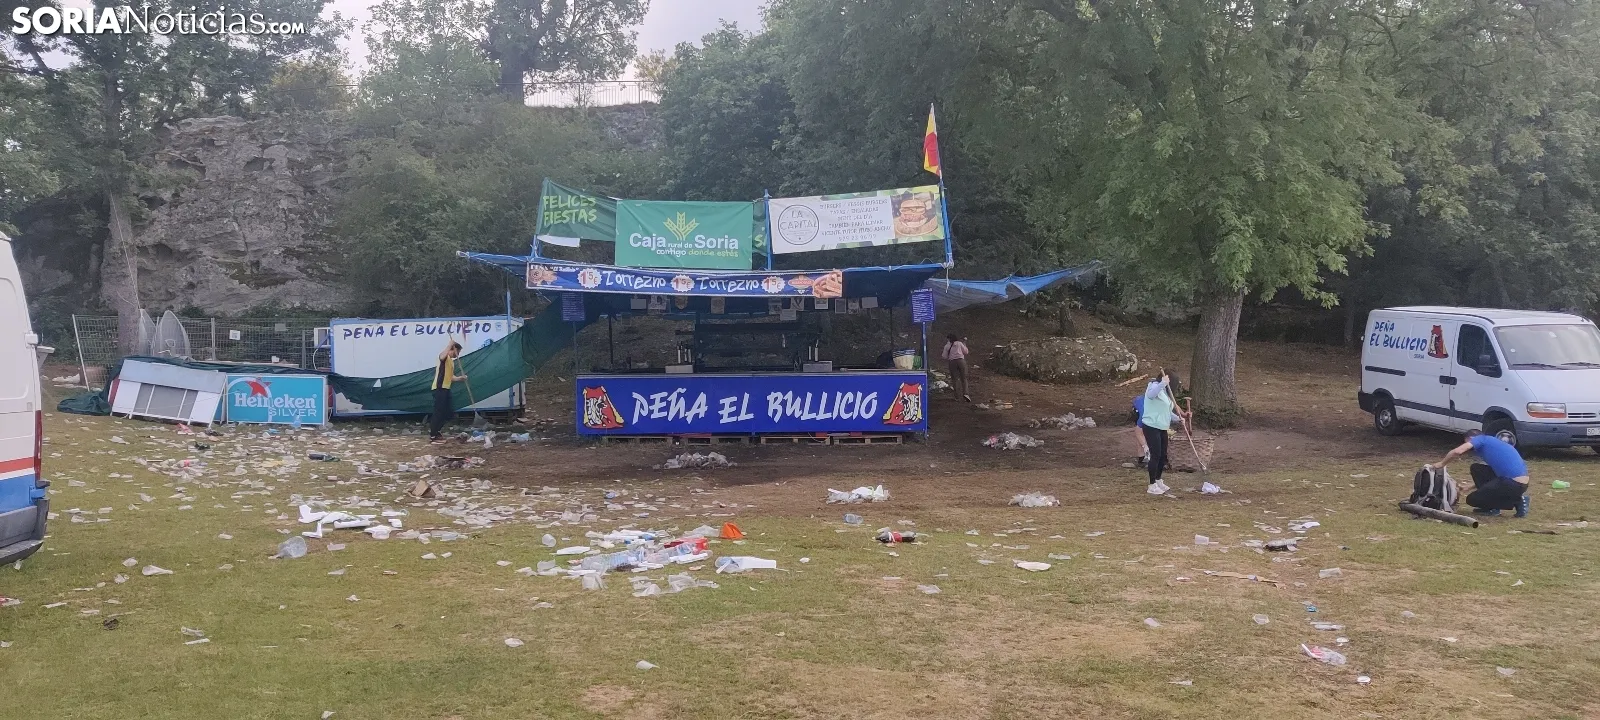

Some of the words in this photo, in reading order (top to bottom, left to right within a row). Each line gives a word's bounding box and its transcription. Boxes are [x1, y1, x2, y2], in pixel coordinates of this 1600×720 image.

[542, 194, 597, 210] FELICES
[543, 208, 597, 229] FIESTAS
[791, 210, 804, 219] LA
[780, 219, 817, 231] CAPITAL
[629, 232, 666, 250] Caja
[694, 234, 739, 249] Soria
[656, 248, 686, 257] contigo
[688, 248, 715, 256] donde
[602, 270, 666, 289] Torrezno
[696, 276, 759, 292] Torrezno
[342, 324, 384, 340] PEÑA
[390, 324, 409, 337] EL
[1374, 320, 1395, 333] PEÑA
[1369, 332, 1380, 347] EL
[1382, 333, 1428, 352] BULLICIO
[234, 392, 316, 409] Heineken
[632, 388, 708, 425] PEÑA
[719, 392, 755, 425] EL
[766, 390, 878, 423] BULLICIO
[268, 408, 317, 417] SILVER
